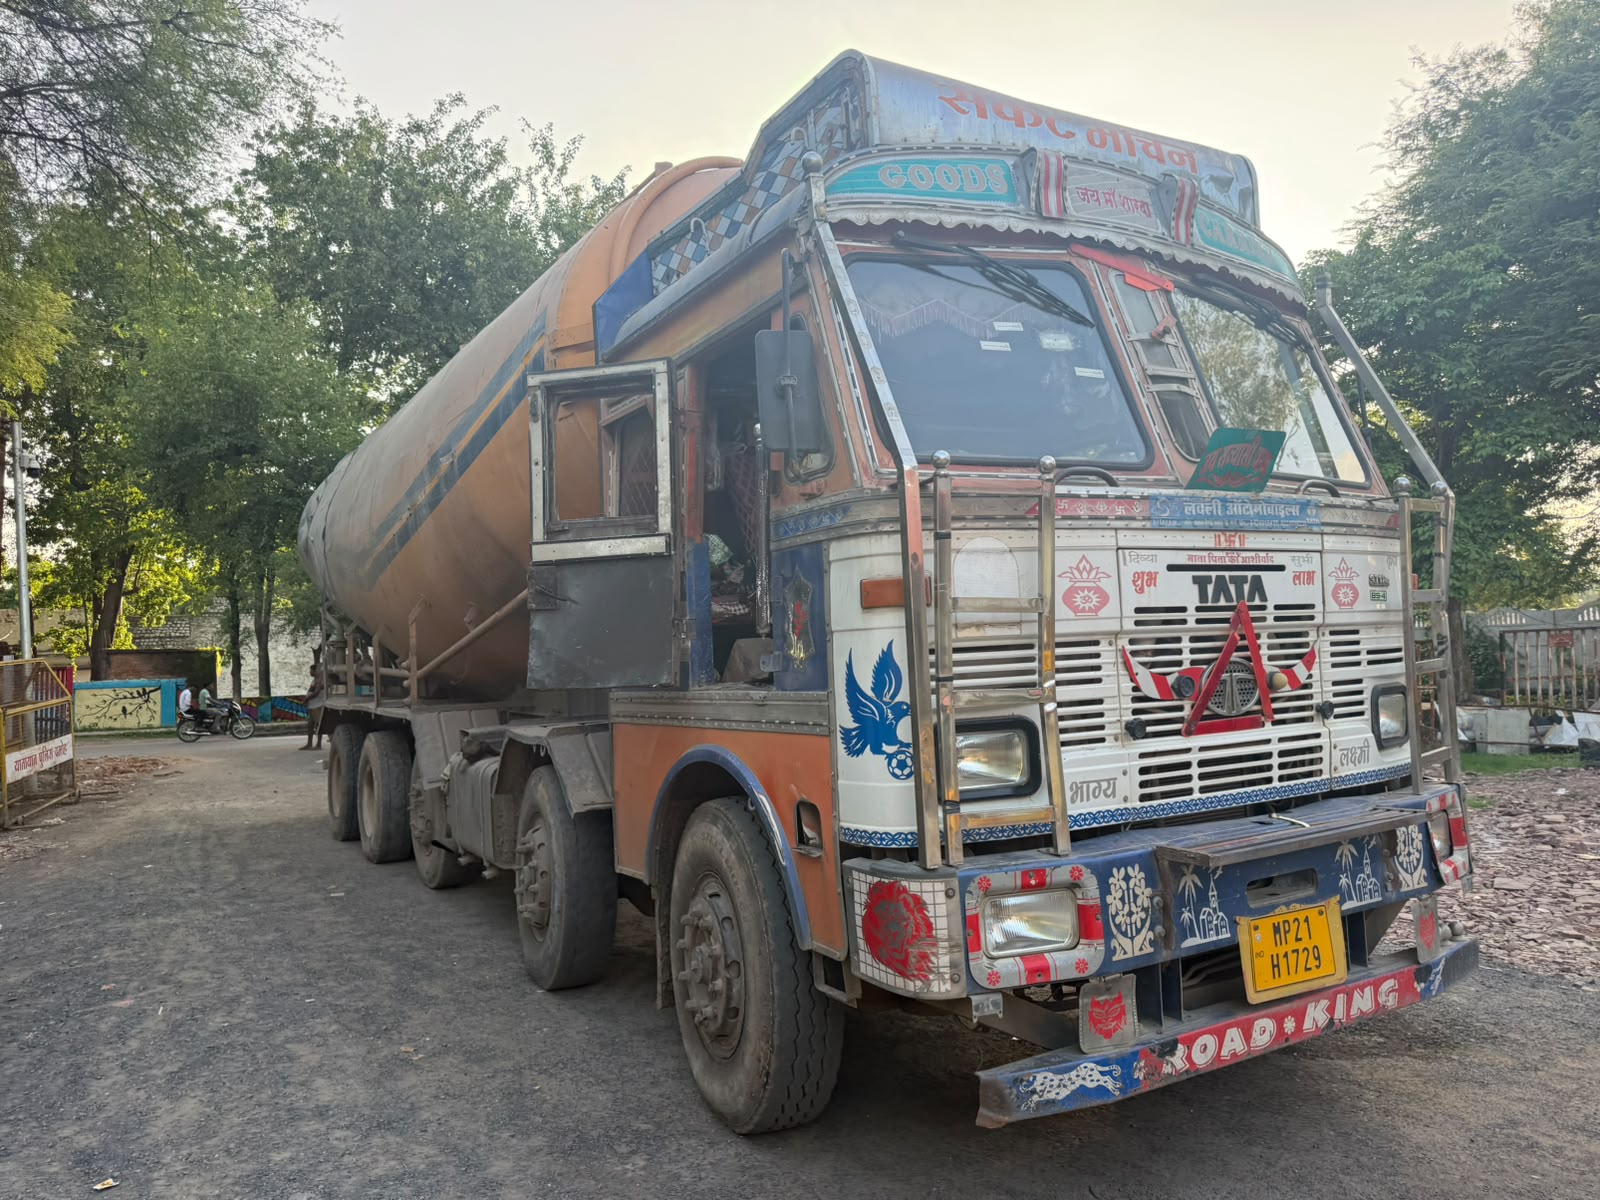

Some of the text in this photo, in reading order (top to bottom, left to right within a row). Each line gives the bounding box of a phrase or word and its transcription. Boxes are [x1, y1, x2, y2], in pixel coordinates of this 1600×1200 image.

[878, 164, 1008, 194] GOODS
[1075, 186, 1101, 207] जय
[1132, 571, 1159, 594] शुभ
[1192, 574, 1268, 604] TATA
[1292, 570, 1316, 586] लाभ
[1339, 739, 1370, 768] लक्ष्मी
[1069, 777, 1118, 804] भाग्य
[1272, 915, 1312, 947] MP21
[1271, 945, 1322, 980] H1729
[1164, 978, 1398, 1074] ROAD KING
